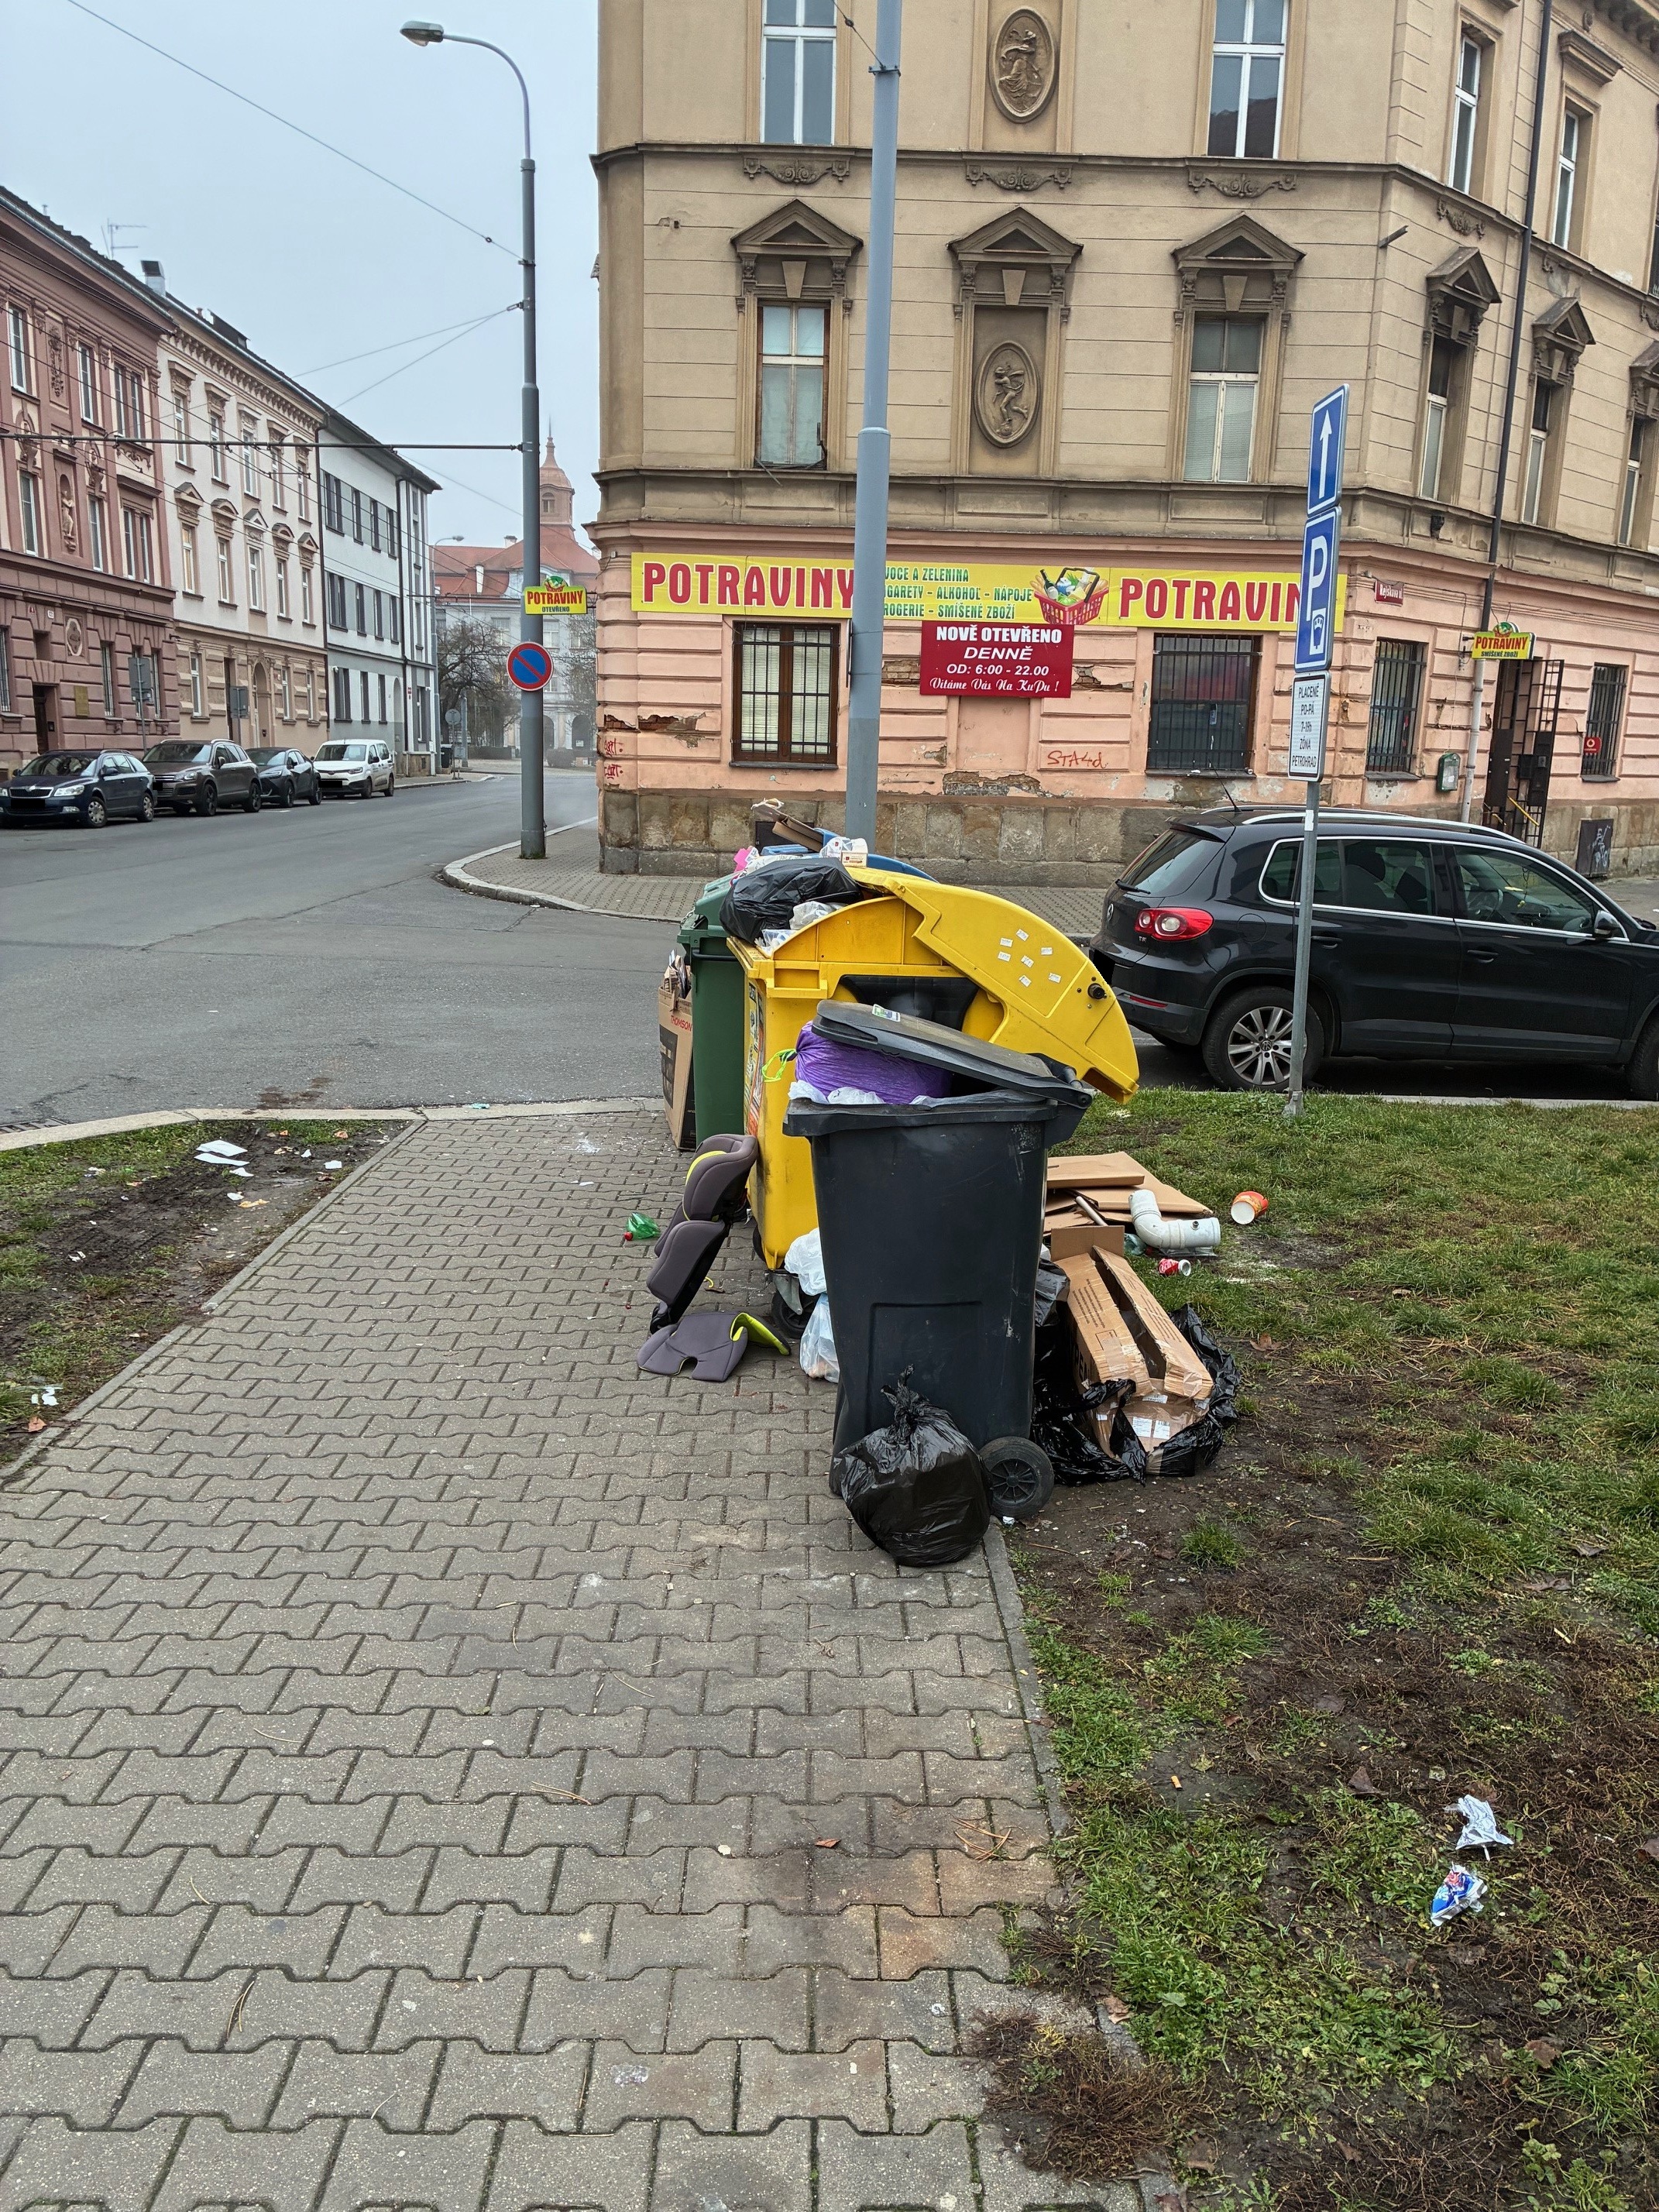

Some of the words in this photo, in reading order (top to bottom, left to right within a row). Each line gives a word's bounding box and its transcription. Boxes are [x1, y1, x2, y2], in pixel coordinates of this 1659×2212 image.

[912, 568, 919, 581] A
[922, 568, 969, 582] ZELENINA
[1307, 535, 1327, 622] P
[644, 562, 854, 609] POTRAVINY
[527, 590, 583, 605] POTRAVINY
[994, 586, 1032, 602] NÁPOJE
[1120, 578, 1300, 623] POTRAVIN
[883, 603, 925, 617] ROGERIE
[938, 602, 983, 619] SMÍŠENÉ
[986, 603, 1015, 620] ZBOŽÍ
[936, 624, 977, 641] NOVĚ
[981, 625, 1062, 644] OTEVŘENO
[1475, 636, 1528, 650] POTRAVINY
[963, 645, 1033, 661] DENNĚ
[946, 664, 971, 674] OD:
[975, 664, 1003, 675] 6:00
[1015, 665, 1049, 676] 22.00
[971, 678, 992, 690] Vás
[995, 678, 1013, 691] Na
[1298, 683, 1320, 699] PLACENÉ
[1301, 701, 1314, 715] PO-PÁ
[1299, 736, 1311, 750] ZÓNA
[1291, 755, 1317, 768] PETROHRAD
[671, 1015, 692, 1032] THOMSON
